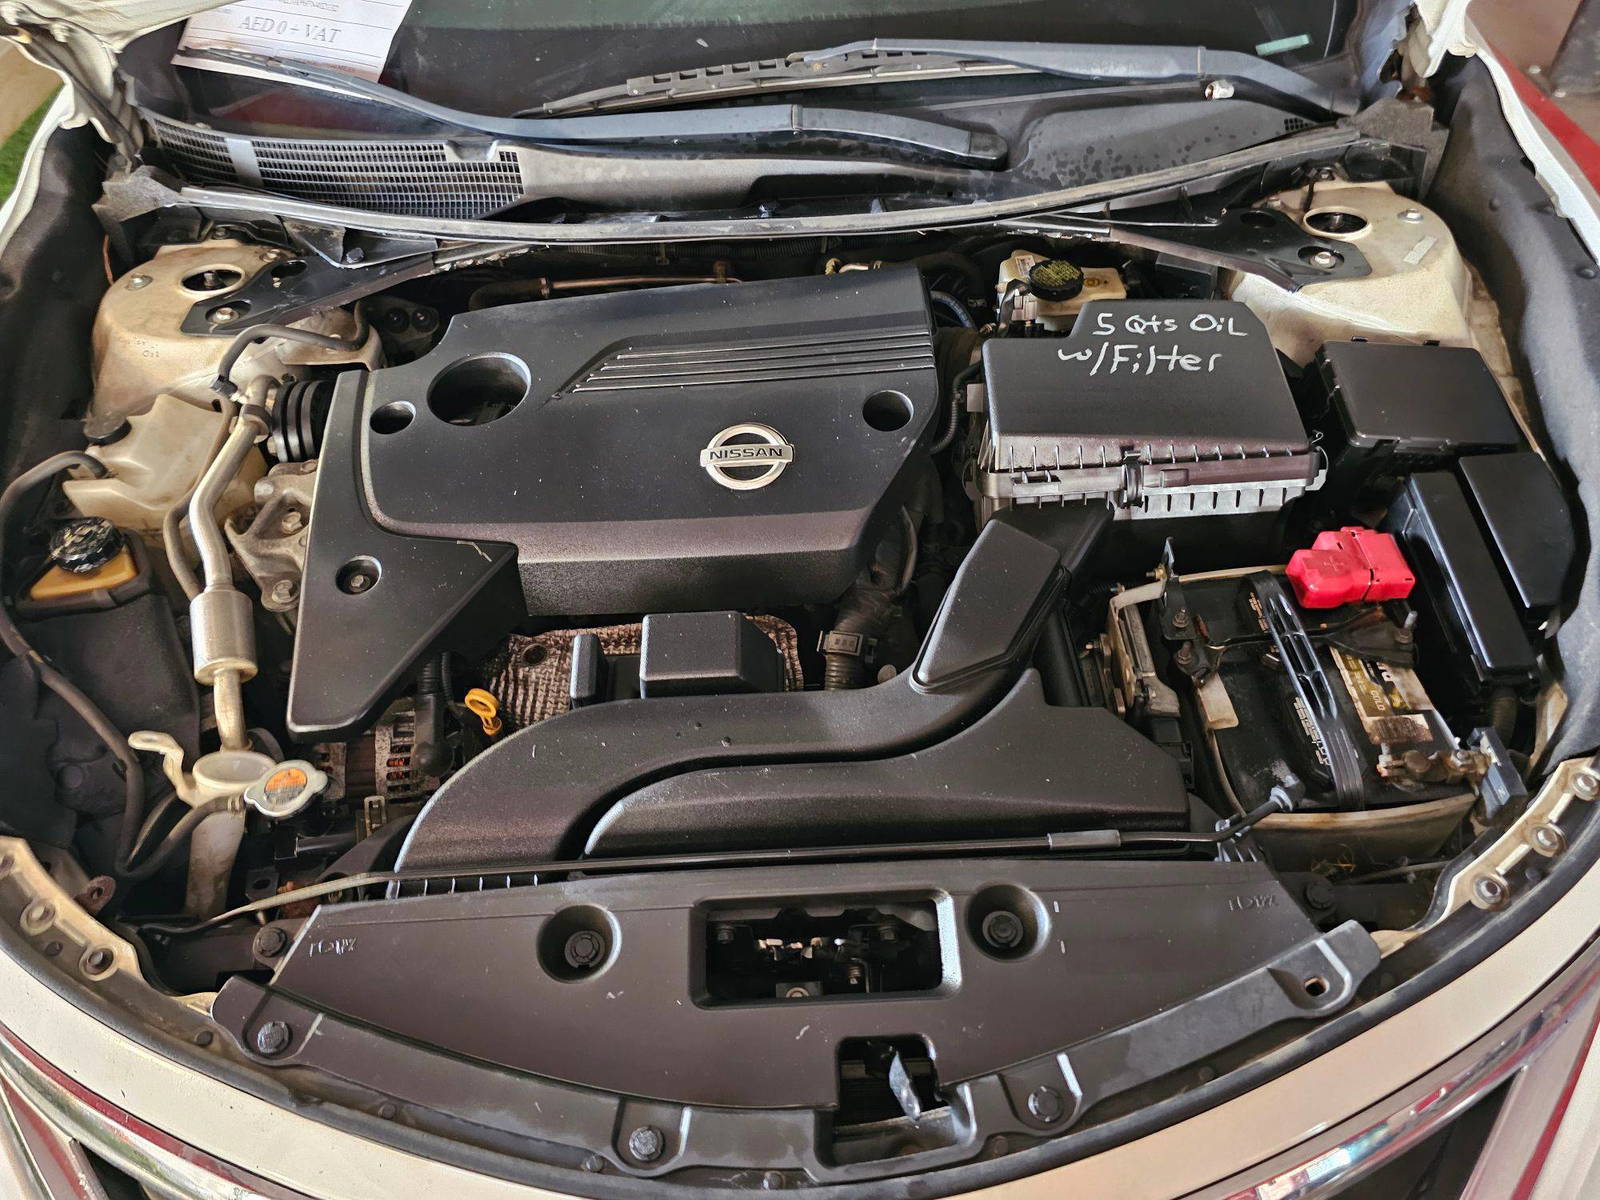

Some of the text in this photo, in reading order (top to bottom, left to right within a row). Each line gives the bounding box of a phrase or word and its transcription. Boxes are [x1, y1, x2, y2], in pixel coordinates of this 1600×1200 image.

[305, 24, 342, 43] VAT
[1124, 315, 1178, 335] Qts
[709, 447, 783, 460] NISSAN
